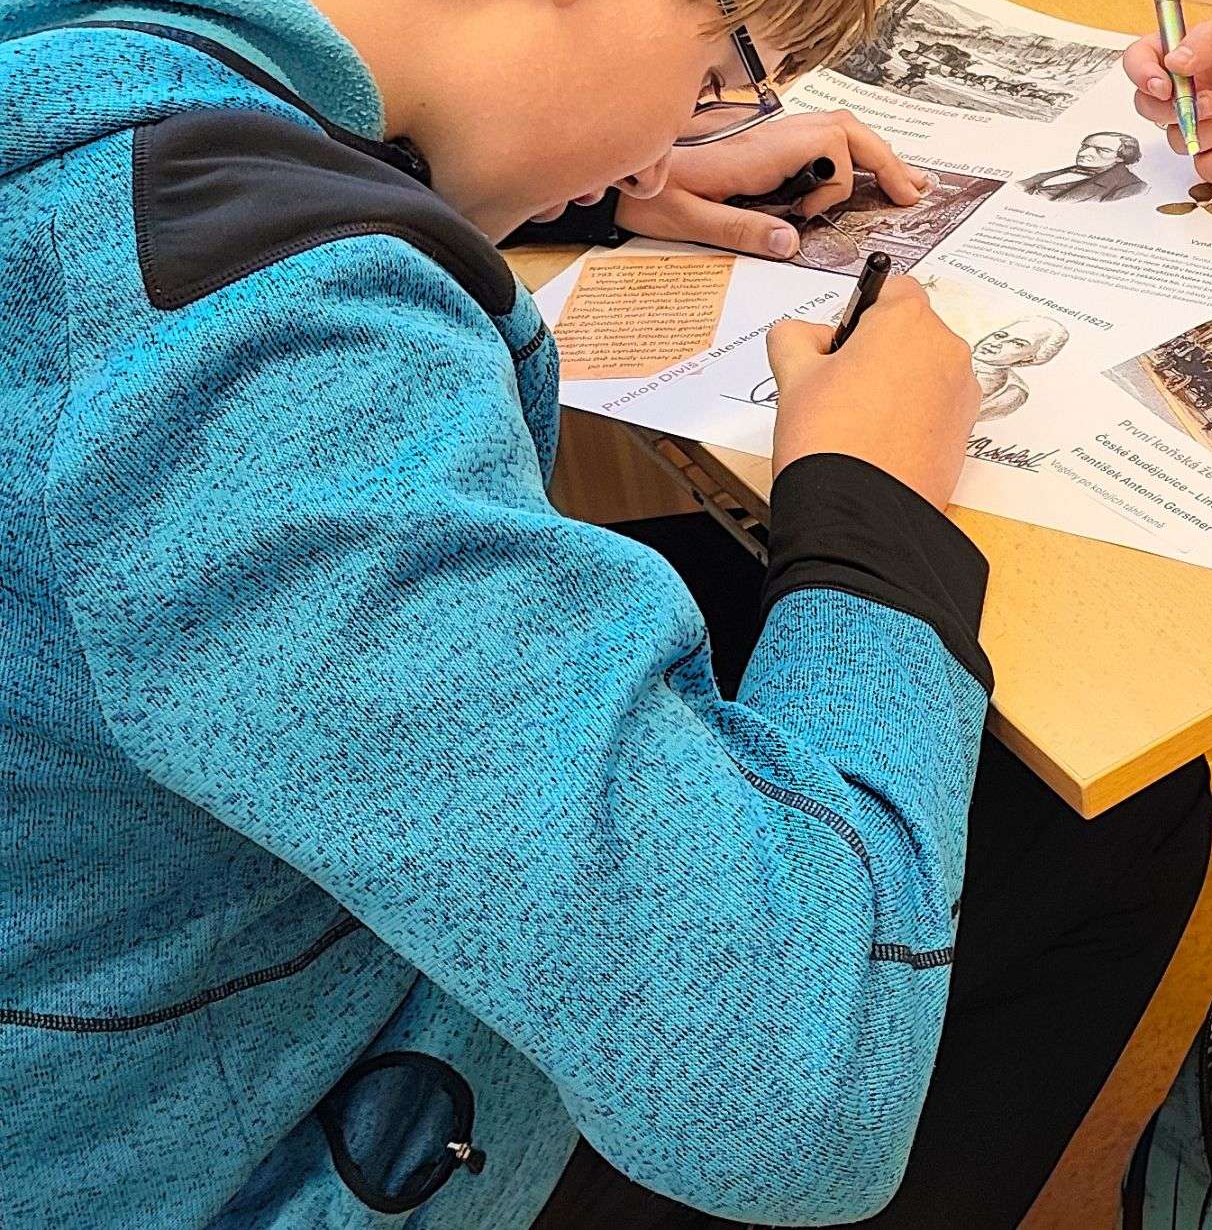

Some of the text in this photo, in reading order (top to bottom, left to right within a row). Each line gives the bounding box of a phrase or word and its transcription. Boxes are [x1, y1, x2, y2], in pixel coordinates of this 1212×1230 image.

[978, 270, 1009, 290] šroub
[1014, 287, 1046, 308] Josef
[601, 381, 660, 412] Prokop
[658, 360, 700, 385] Diviš
[794, 289, 840, 315] (1754)
[1095, 433, 1132, 459] České
[1127, 452, 1189, 492] Budějovice
[1118, 419, 1155, 444] První
[1151, 438, 1200, 471] koňská
[1071, 447, 1123, 481] František
[1120, 476, 1165, 506] Antonín
